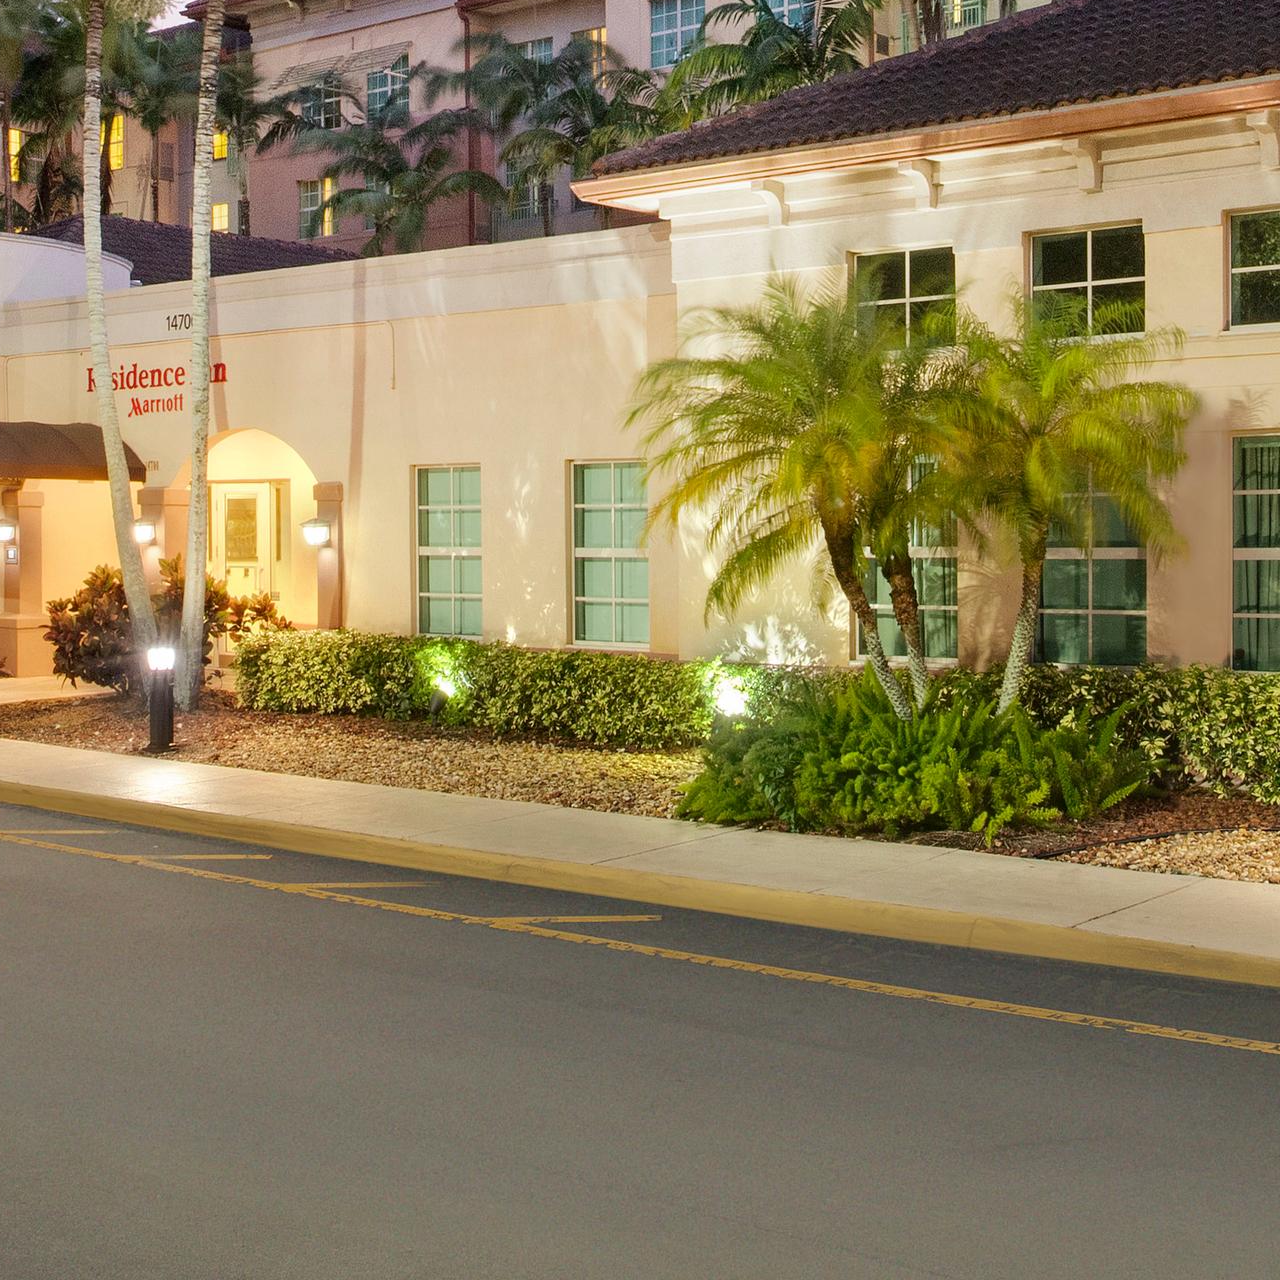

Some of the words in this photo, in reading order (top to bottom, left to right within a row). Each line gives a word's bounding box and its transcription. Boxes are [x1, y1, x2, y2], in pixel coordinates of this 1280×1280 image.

[166, 314, 193, 331] 1470
[87, 363, 185, 392] Rsidence
[128, 393, 183, 417] Marriott
